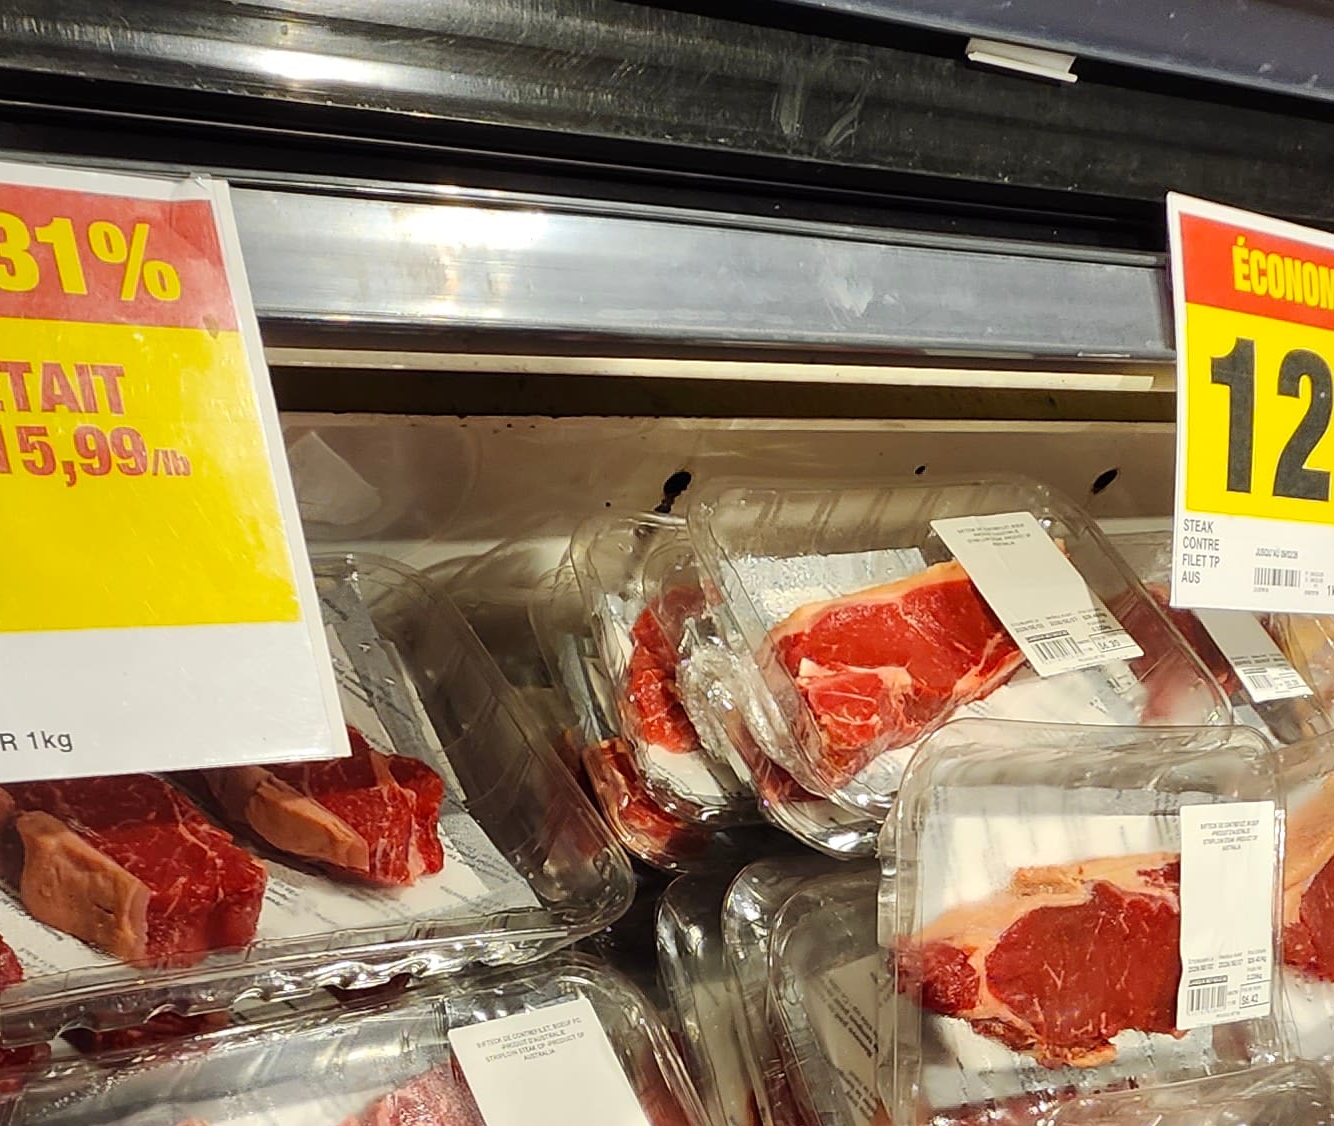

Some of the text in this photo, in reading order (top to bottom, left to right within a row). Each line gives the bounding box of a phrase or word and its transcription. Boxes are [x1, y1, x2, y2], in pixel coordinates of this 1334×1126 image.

[1183, 518, 1214, 534] STEAK
[1183, 536, 1220, 552] CONTRE
[1182, 553, 1220, 568] FILET TP
[1182, 571, 1201, 585] AUS
[27, 730, 73, 753] 1kg
